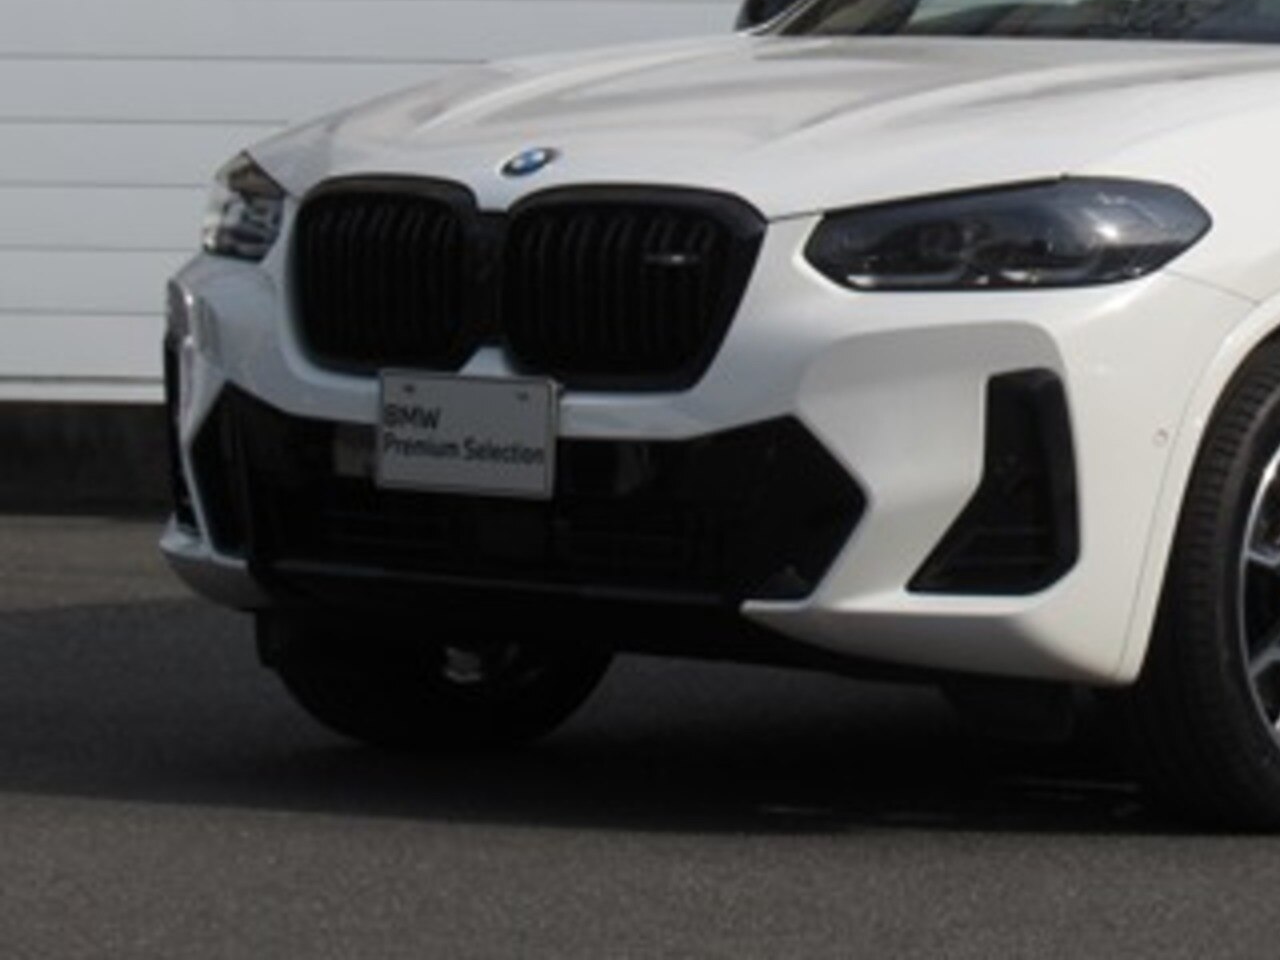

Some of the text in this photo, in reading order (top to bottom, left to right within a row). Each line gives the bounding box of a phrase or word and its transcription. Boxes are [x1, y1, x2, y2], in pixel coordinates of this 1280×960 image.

[383, 403, 441, 429] BMW
[383, 431, 545, 464] Premium Selection
